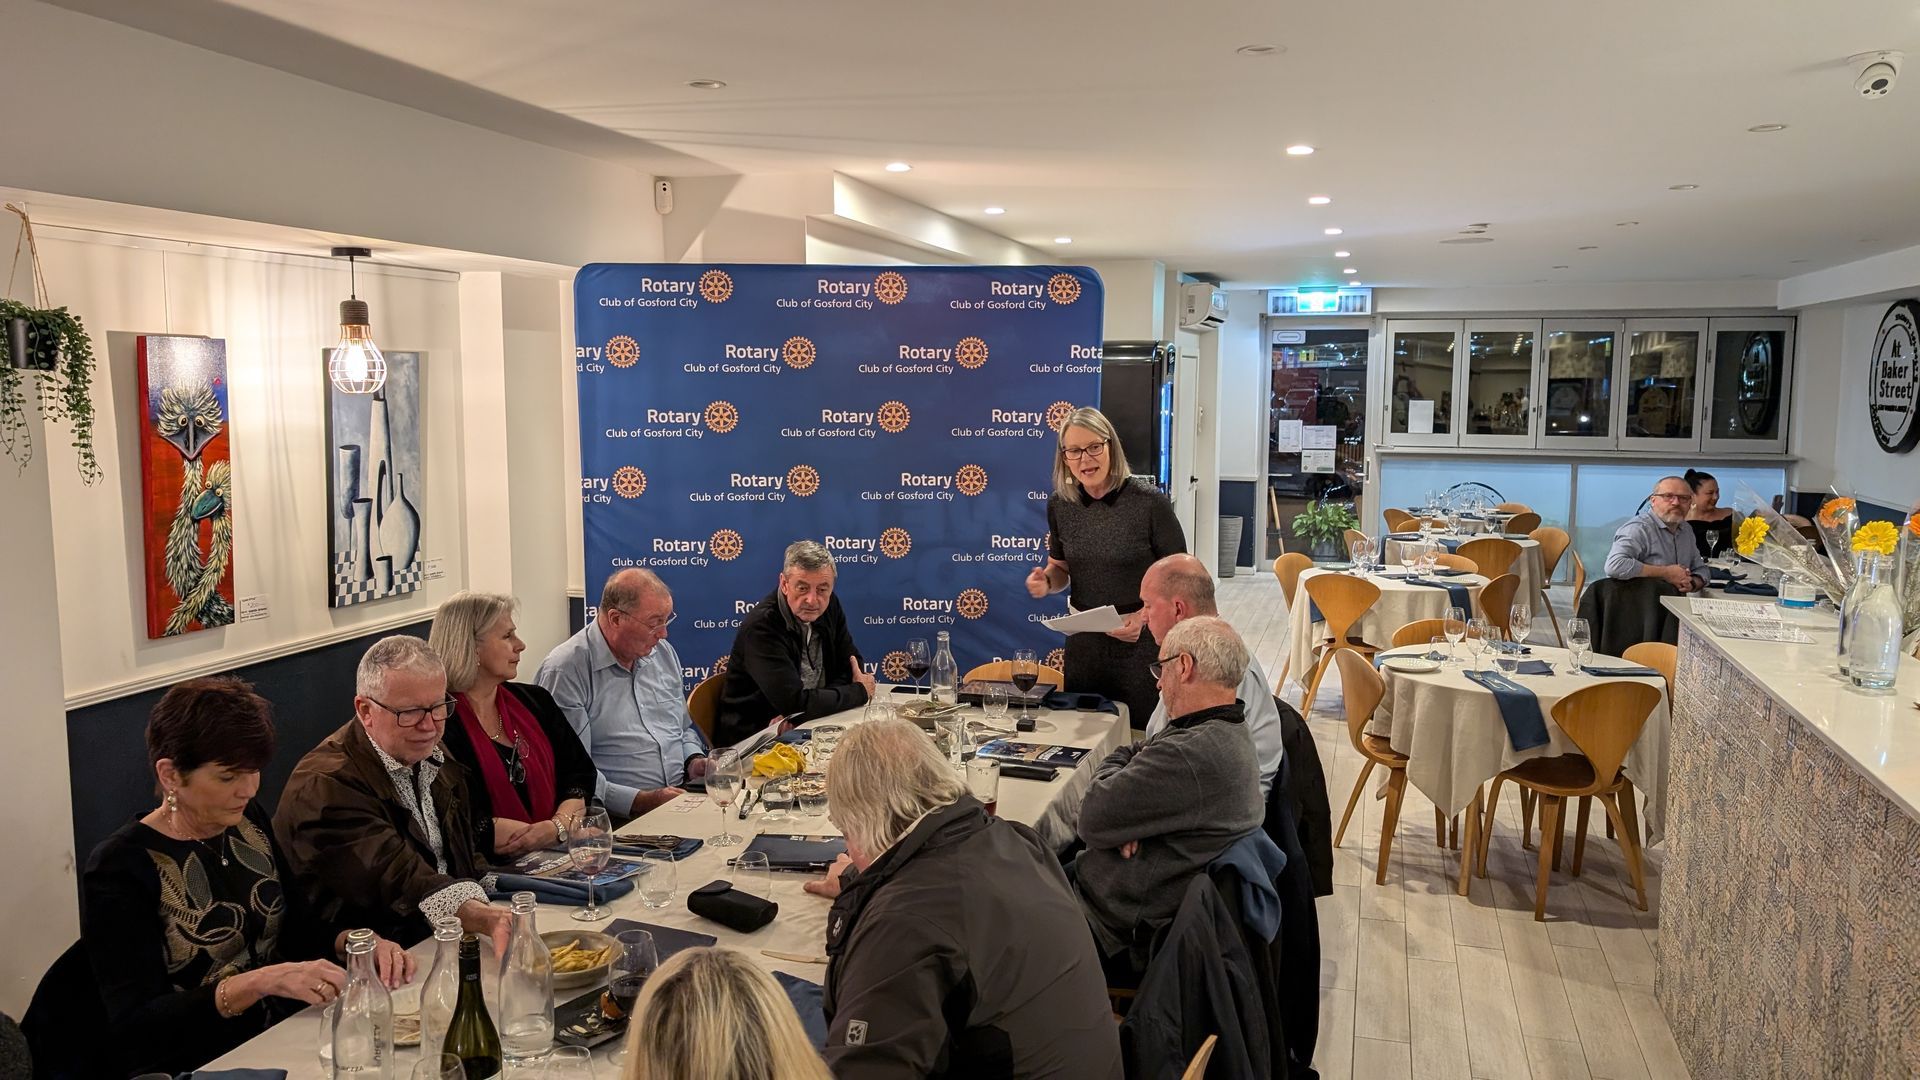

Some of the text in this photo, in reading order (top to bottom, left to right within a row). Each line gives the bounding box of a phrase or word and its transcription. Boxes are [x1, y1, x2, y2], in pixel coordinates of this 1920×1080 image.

[641, 277, 696, 296] Rotary
[817, 279, 871, 297] Rotary
[991, 281, 1044, 298] Rotary
[599, 297, 698, 309] Club of Gosford City
[776, 298, 873, 310] Club of Gosford City
[950, 300, 1047, 311] Club of Gosford City
[725, 343, 779, 361] Rotary
[899, 344, 952, 362] Rotary
[1890, 339, 1902, 358] At
[586, 363, 605, 375] City
[684, 363, 782, 375] Club of Gosford City
[858, 363, 954, 375] Club of Gosford City
[1029, 363, 1102, 374] Club of Gosford
[1881, 361, 1909, 379] Baker
[1879, 380, 1913, 399] Street
[647, 408, 702, 427] Rotary
[821, 408, 875, 426] Rotary
[991, 408, 1043, 426] Rotary
[606, 428, 704, 440] Club of Gosford City
[781, 428, 877, 439] Club of Gosford City
[951, 427, 1045, 439] Club of Gosford City
[730, 472, 784, 490] Rotary
[901, 472, 953, 489] Rotary
[593, 493, 612, 504] City
[689, 492, 786, 503] Club of Gosford City
[861, 491, 954, 502] Club of Gosford City
[1028, 491, 1048, 500] Club
[653, 538, 707, 555] Rotary
[825, 535, 877, 552] Rotary
[991, 534, 1042, 551] Rotary
[611, 556, 709, 568] Club of Gosford City
[834, 554, 879, 565] sford City
[952, 552, 1044, 563] Club of Gosford City
[903, 597, 954, 613] Rotary
[694, 619, 715, 628] Club
[718, 619, 729, 628] of
[863, 615, 956, 627] Club of Gosford City
[1028, 613, 1048, 622] Club
[682, 663, 709, 679] ary
